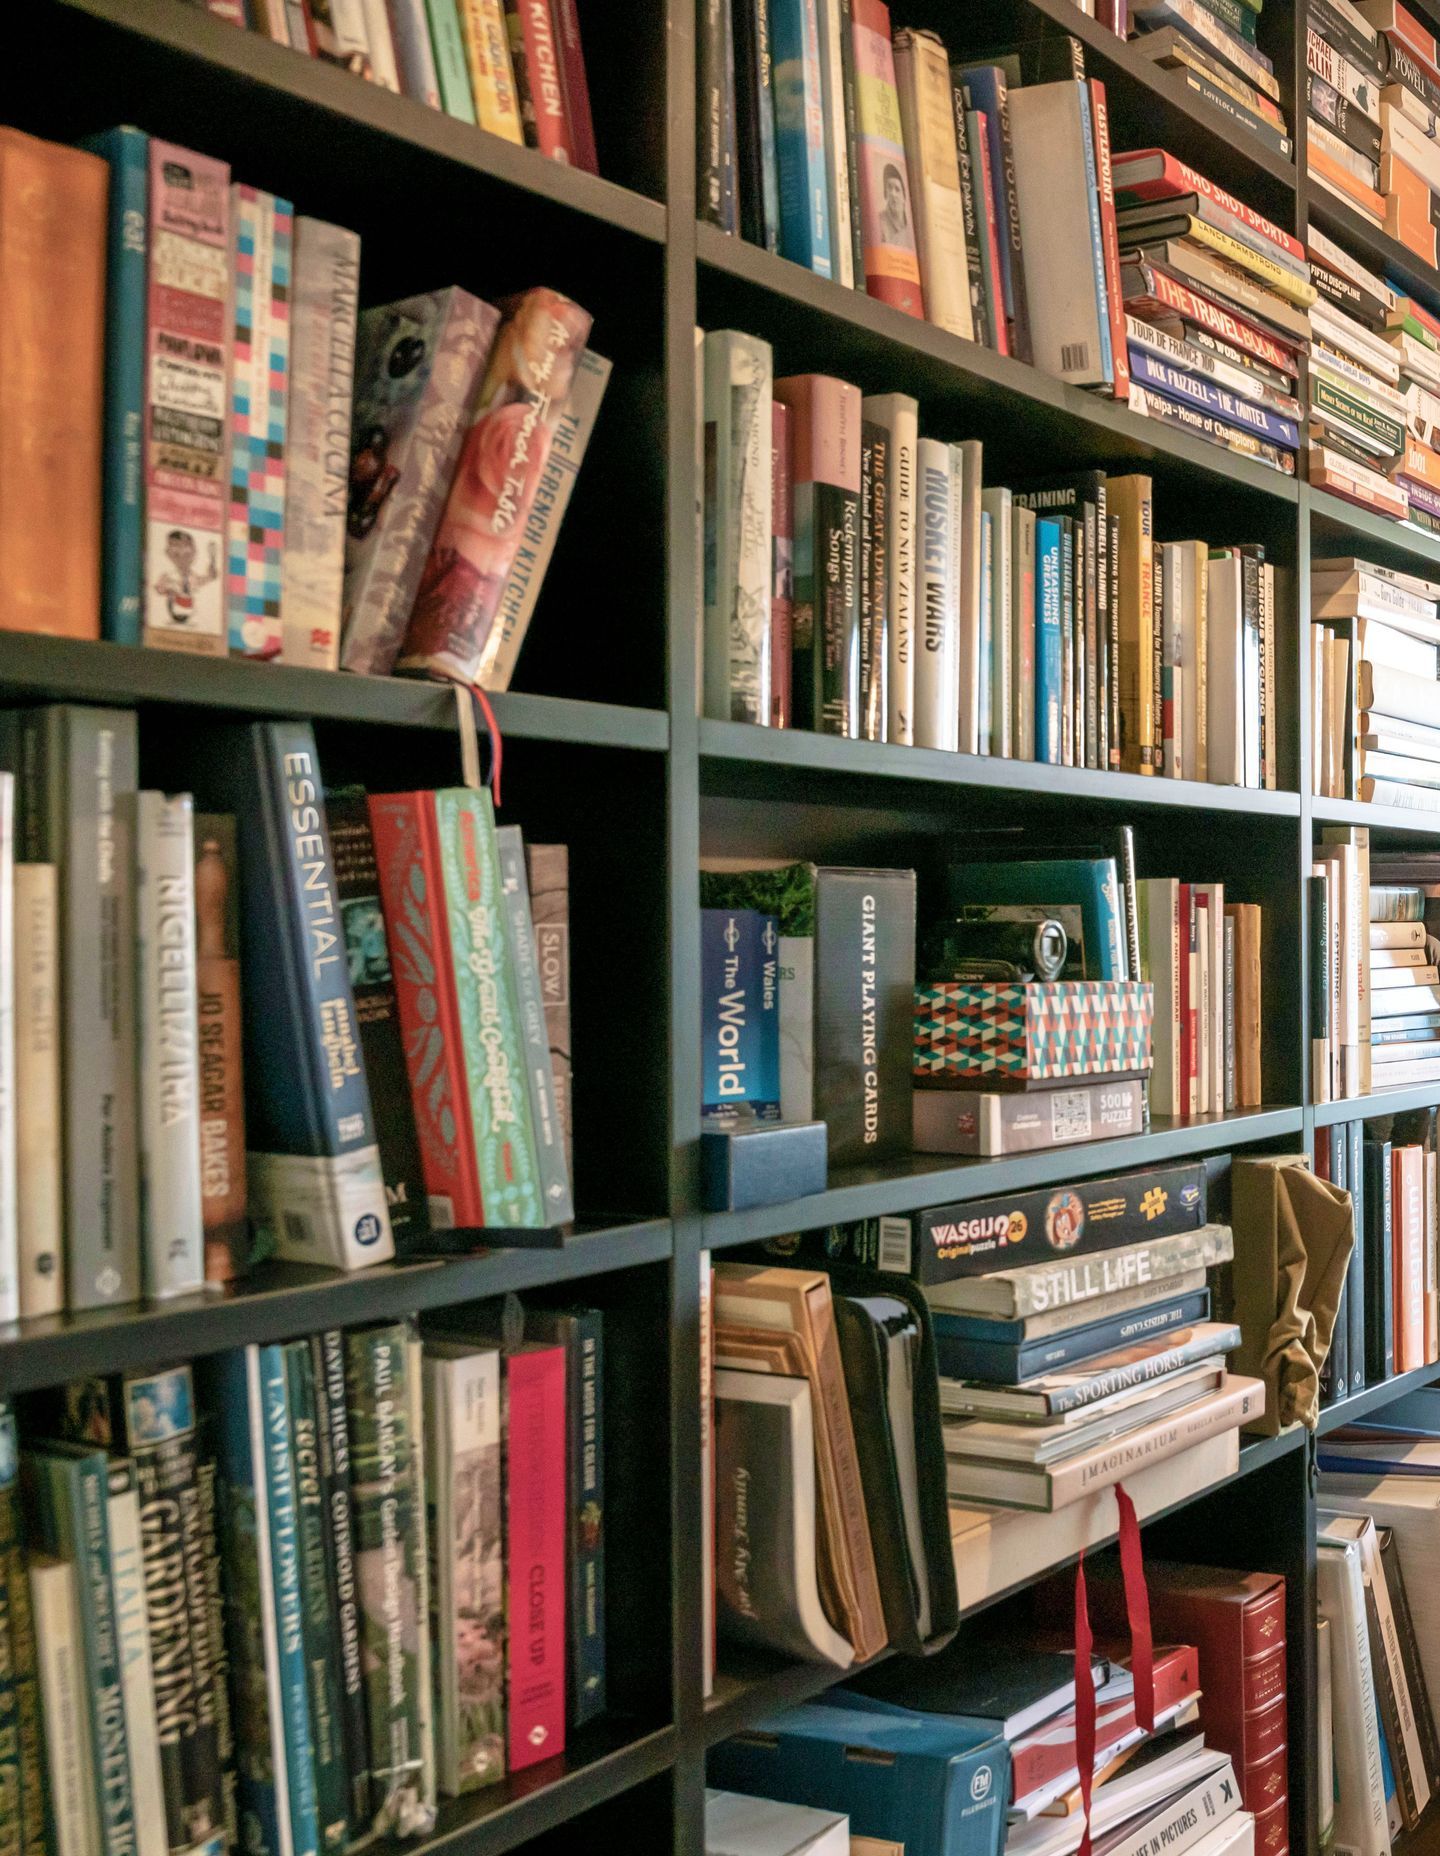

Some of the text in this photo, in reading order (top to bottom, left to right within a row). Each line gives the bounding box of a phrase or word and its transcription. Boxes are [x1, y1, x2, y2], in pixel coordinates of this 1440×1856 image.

[528, 2, 563, 117] KITCHEN
[1395, 48, 1426, 97] POWELL
[1203, 89, 1235, 120] LOVELOCK
[1097, 104, 1112, 205] CASTLEPOINT
[1179, 161, 1290, 248] WHO SHOT SPORTS
[1198, 222, 1282, 276] LANCE ARMSTRONG
[1311, 263, 1361, 301] FIFTH DISCIPLINE
[550, 319, 570, 350] At
[1131, 320, 1155, 343] TOUR
[1156, 333, 1168, 350] DE
[1169, 338, 1200, 365] FRANCE
[1155, 275, 1282, 366] THE TRAVEL BOOK
[323, 255, 358, 519] MARCELLA CUCINA
[1343, 361, 1358, 378] GREAT
[509, 386, 552, 470] French
[1178, 408, 1203, 428] Home
[1204, 419, 1214, 433] of
[1214, 422, 1257, 451] Champions
[1217, 387, 1235, 411] THE
[1235, 398, 1269, 430] PAINTER
[874, 442, 885, 478] THE
[1408, 451, 1426, 474] 1001
[491, 475, 526, 535] Table
[499, 413, 580, 643] THE FRENCH KITCHEN
[874, 483, 885, 543] GREAT
[826, 501, 856, 607] Redemption Songs
[861, 450, 871, 662] New Zealand and France on the Western
[898, 446, 909, 664] GUIDE TO NEW ZEALAND
[925, 467, 948, 652] MUSKET WARS
[1099, 487, 1107, 609] KETTLEBELL TRAINING
[1043, 547, 1059, 625] UNLEASHING GREATNESS
[1154, 637, 1162, 648] for
[1154, 693, 1163, 724] Athletes
[284, 753, 339, 979] ESSENTIAL
[513, 911, 542, 1045] SHADES GREY
[542, 933, 561, 996] SLOW
[764, 962, 776, 1009] Wales
[719, 956, 745, 1096] The World
[862, 895, 879, 1145] GIANT PLAYING CARDS
[201, 1022, 225, 1112] SEAGAR
[1101, 1093, 1121, 1109] 500
[1101, 1109, 1132, 1124] PUZZLE
[203, 1119, 229, 1197] BAKES
[1010, 1220, 1024, 1234] 26
[1031, 1251, 1151, 1311] STILL LIFE
[324, 1330, 344, 1399] DAVID
[374, 1346, 392, 1396] PAUL
[1075, 1367, 1143, 1403] SPORTING
[1147, 1351, 1184, 1382] HORSE
[295, 1418, 321, 1505] secret
[1081, 1429, 1178, 1487] IMAGINARIUM
[141, 1500, 197, 1745] GARDENING
[529, 1565, 546, 1665] CLOSE UP
[973, 1775, 989, 1788] FM
[1150, 1808, 1197, 1856] IN PICTURES
